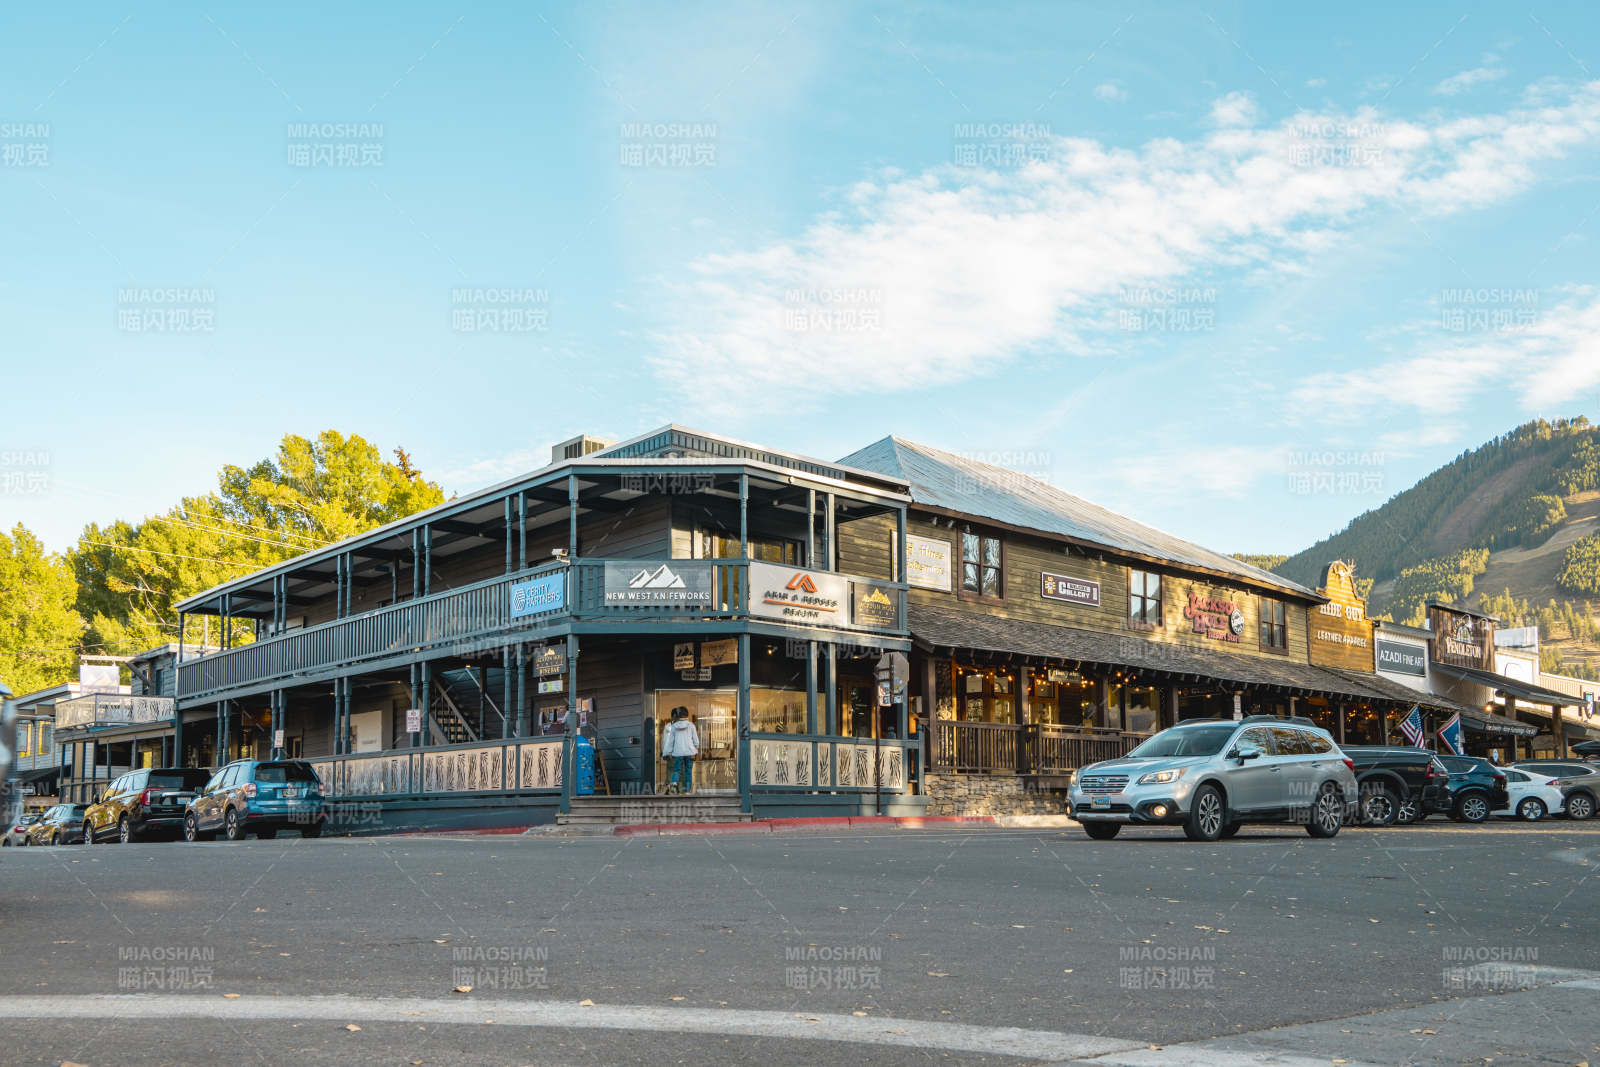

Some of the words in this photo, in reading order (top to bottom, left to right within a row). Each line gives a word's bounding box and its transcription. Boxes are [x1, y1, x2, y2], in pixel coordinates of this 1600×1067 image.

[526, 591, 561, 607] PARTNERS
[606, 592, 624, 600] NEW
[628, 592, 651, 600] WEST
[654, 592, 710, 600] KNIFEWORKS
[1319, 602, 1342, 617] HIDE
[1345, 606, 1364, 621] OUT
[1317, 630, 1342, 643] LEATHER
[1343, 634, 1367, 648] APPAREL
[1446, 636, 1481, 658] PENDLETON
[1380, 650, 1402, 664] AZADI
[1403, 654, 1414, 665] FINE
[1414, 657, 1424, 667] ART
